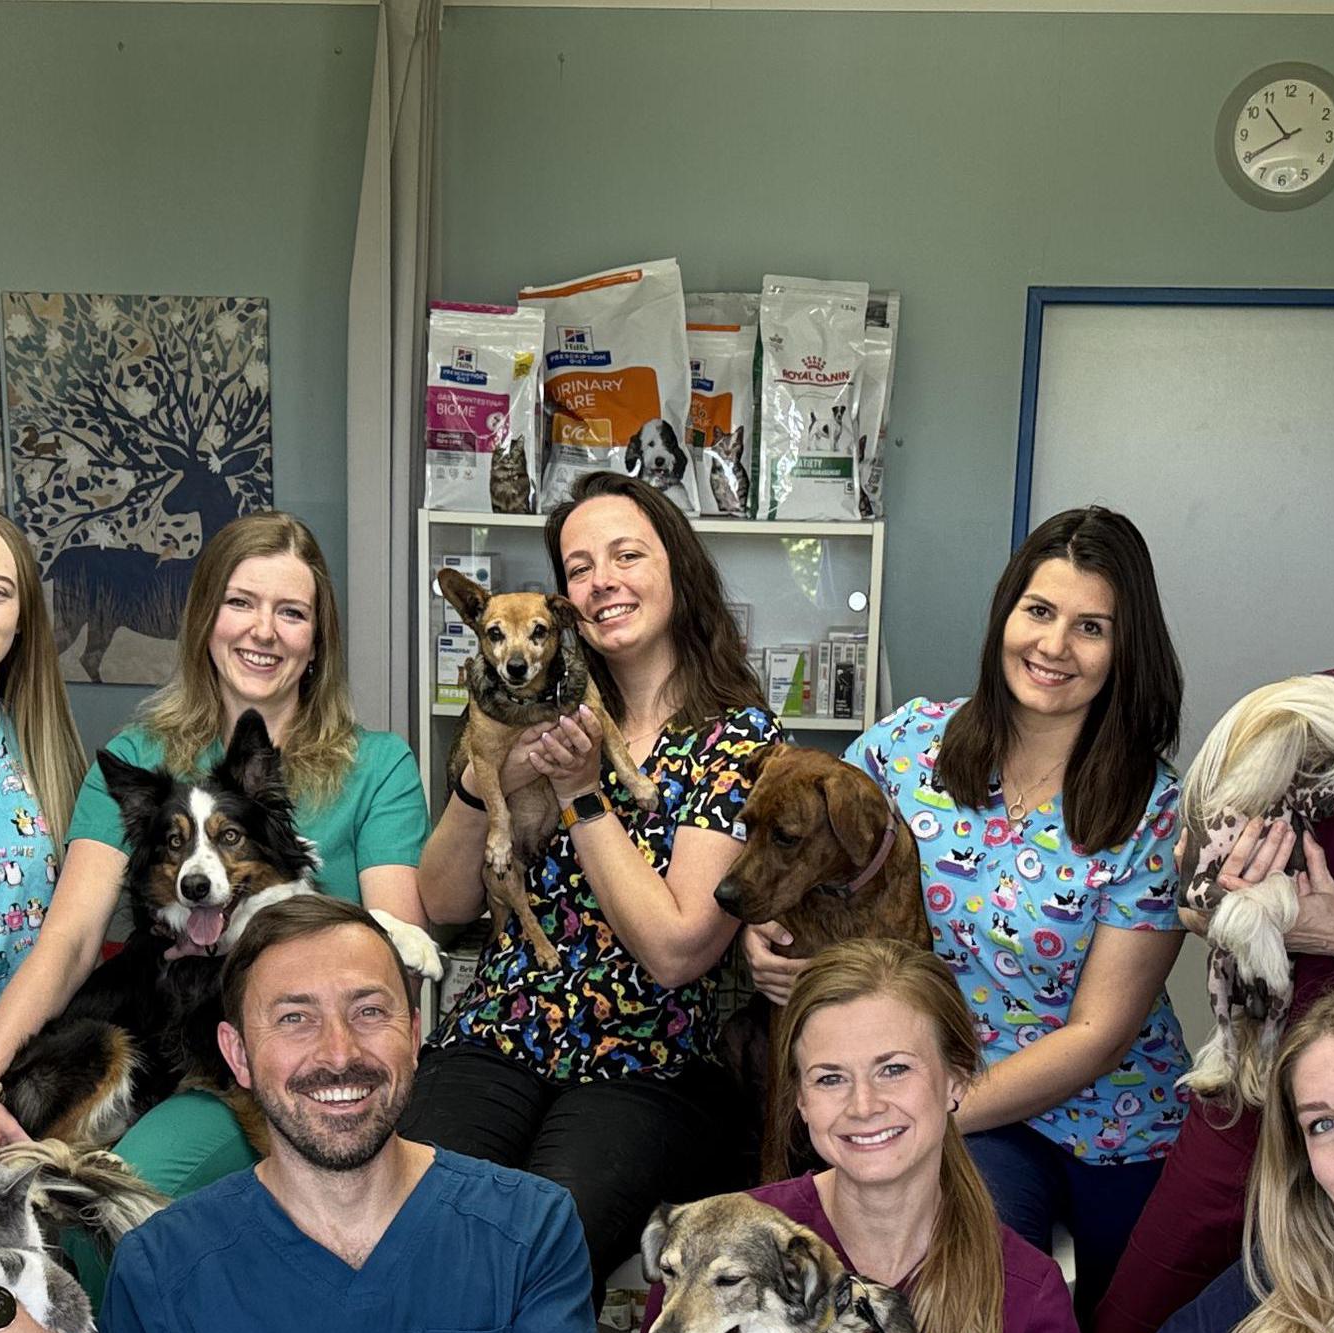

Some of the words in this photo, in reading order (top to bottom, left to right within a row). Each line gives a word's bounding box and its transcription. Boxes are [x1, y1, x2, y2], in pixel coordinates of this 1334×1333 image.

[1285, 85, 1297, 97] 12
[1264, 92, 1275, 104] 11
[1309, 93, 1315, 104] 1
[1247, 107, 1259, 119] 10
[1322, 108, 1331, 121] 2
[1240, 129, 1249, 141] 9
[1325, 131, 1334, 143] 3
[1317, 153, 1325, 165] 4
[1259, 167, 1267, 180] 7
[1300, 169, 1309, 181] 5
[1278, 175, 1286, 186] 6
[782, 369, 813, 382] ROYAL
[816, 371, 850, 383] CANIN
[552, 377, 624, 401] URINARY
[436, 402, 476, 418] BIOME
